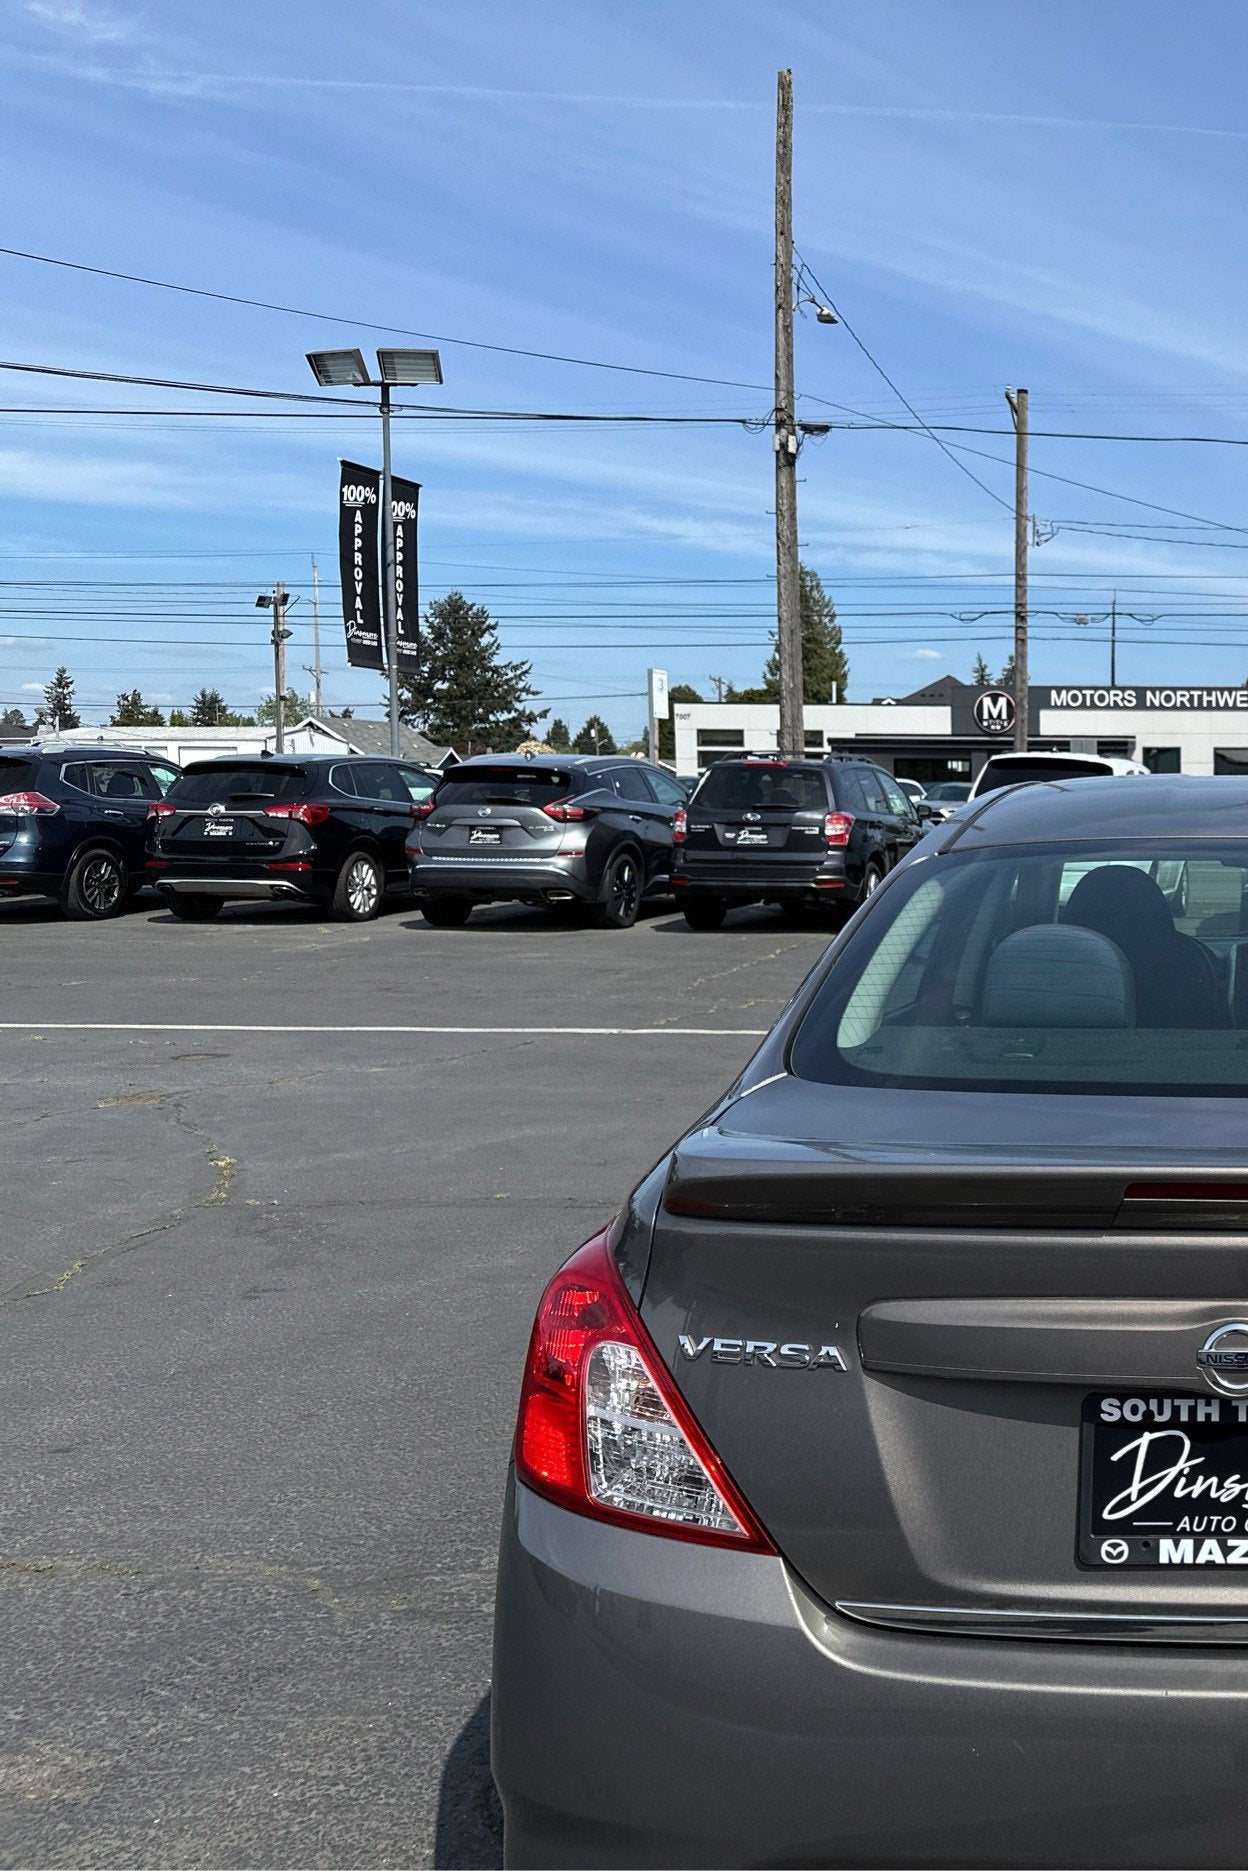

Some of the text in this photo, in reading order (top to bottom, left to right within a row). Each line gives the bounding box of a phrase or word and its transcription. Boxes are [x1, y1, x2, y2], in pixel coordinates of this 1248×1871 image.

[342, 484, 377, 505] 100%
[391, 501, 416, 519] 00%
[354, 510, 363, 624] APPROVAL
[396, 525, 405, 635] APPROVAL
[982, 696, 1008, 720] M
[1050, 689, 1137, 707] MOTORS
[678, 1334, 848, 1372] VERSA
[1100, 1397, 1220, 1423] SOUTH
[1176, 1515, 1237, 1533] AUTO
